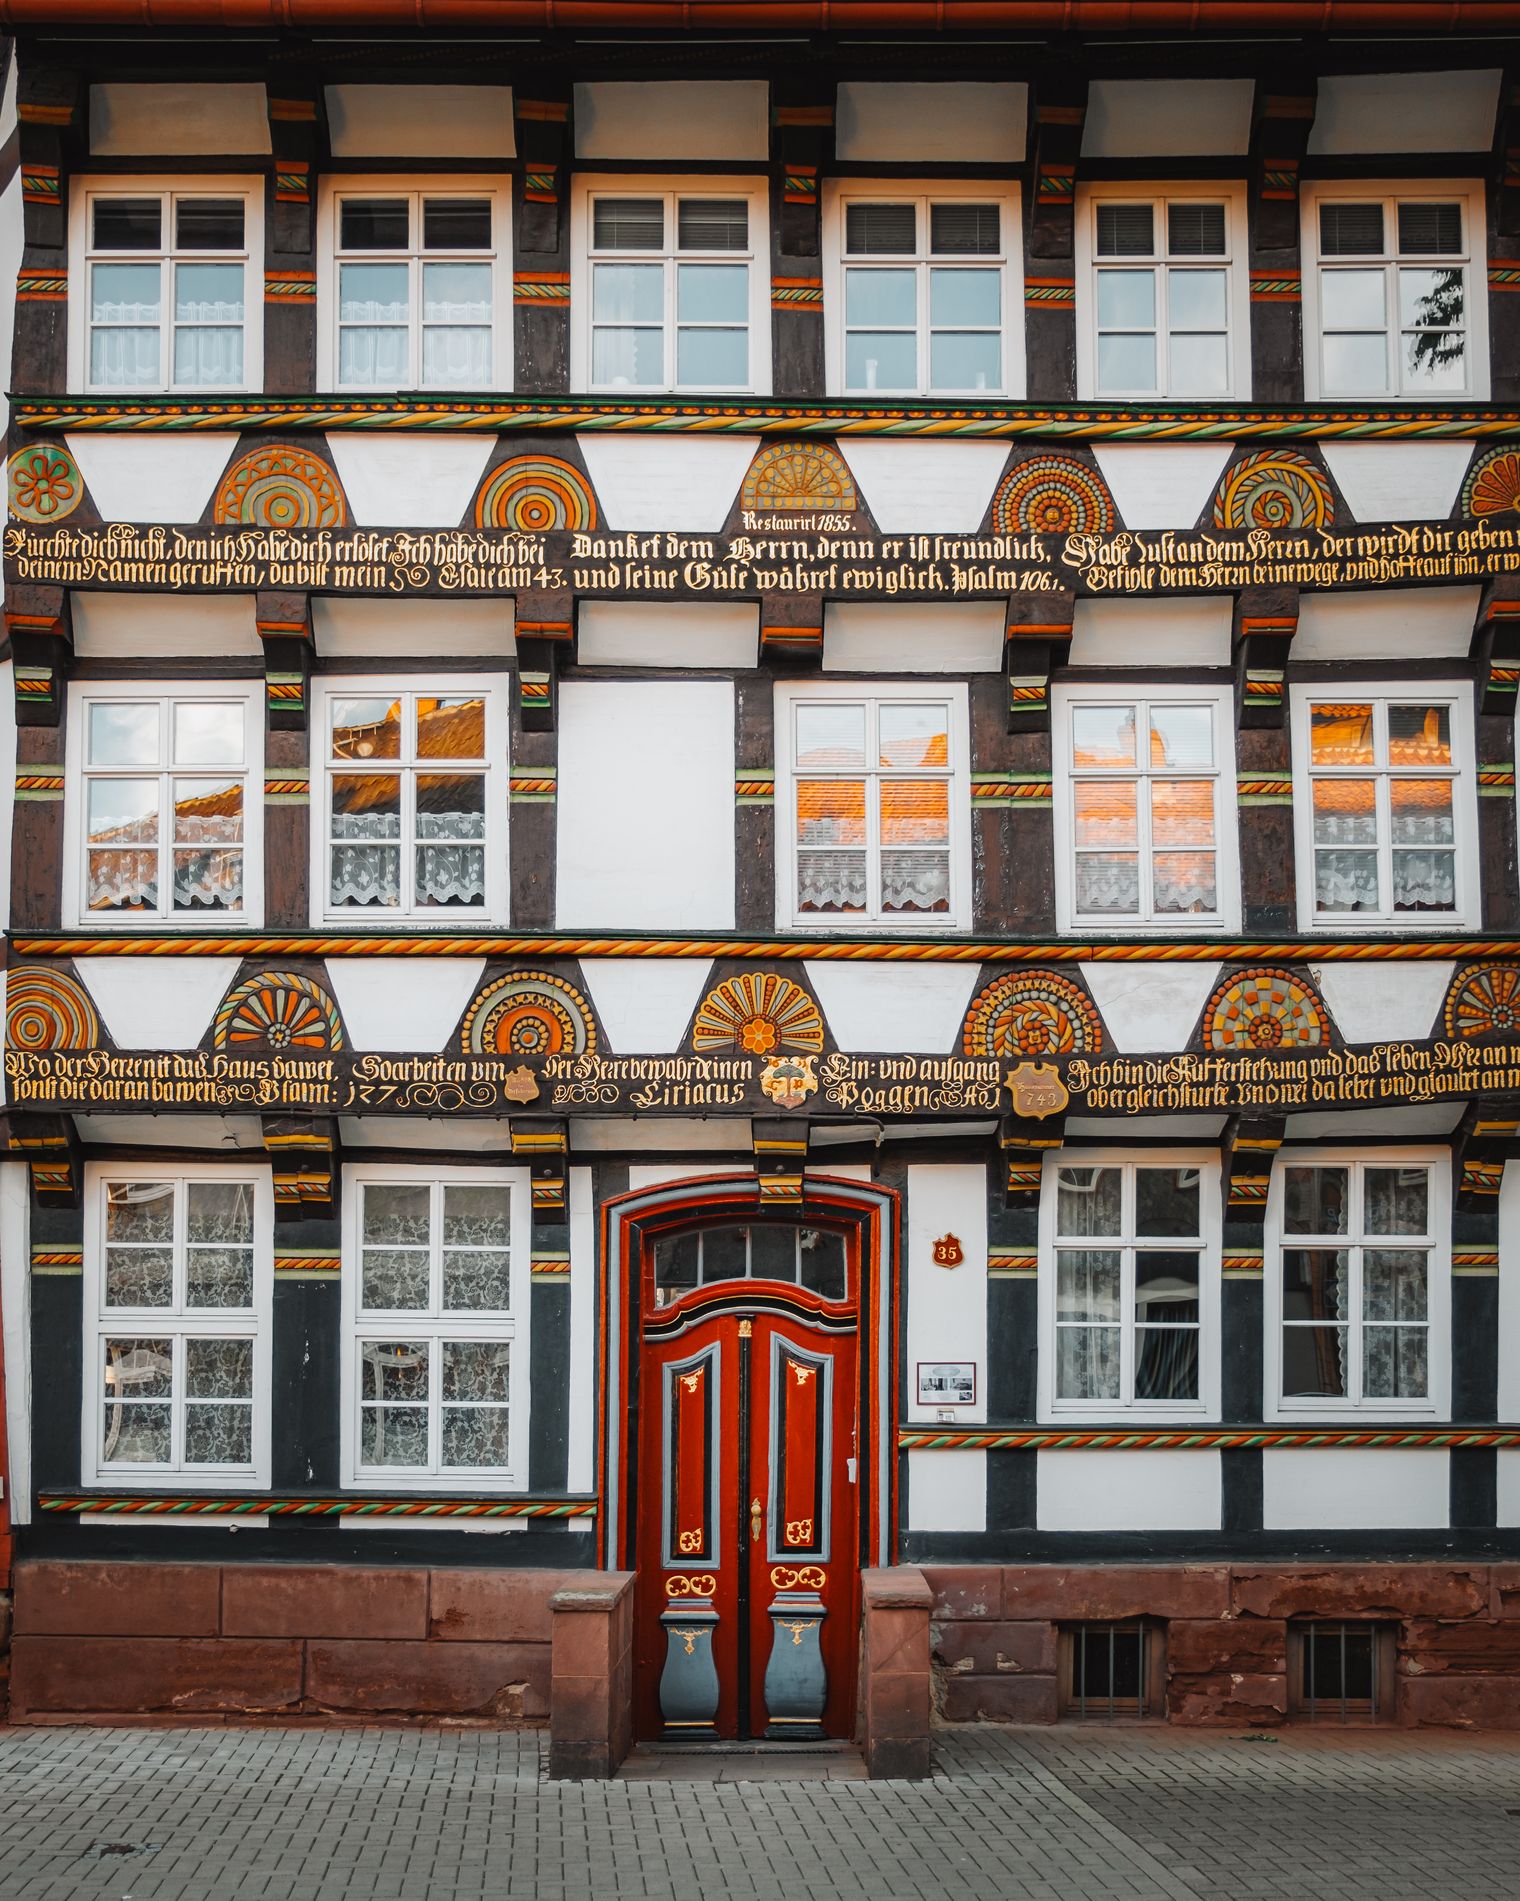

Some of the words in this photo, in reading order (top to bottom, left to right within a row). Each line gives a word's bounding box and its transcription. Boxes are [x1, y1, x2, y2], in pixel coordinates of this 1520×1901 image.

[817, 514, 857, 532] 1855.
[570, 533, 661, 559] Danket
[666, 532, 714, 559] dem
[722, 537, 814, 567] Herrn,
[816, 536, 875, 560] denn
[882, 540, 904, 560] er
[1201, 533, 1244, 562] dem
[1422, 526, 1454, 553] dir
[1457, 519, 1514, 557] geben
[574, 562, 621, 589] und
[683, 562, 748, 590] Güte
[752, 563, 838, 592] währet
[842, 563, 949, 594] ewiglich.
[1159, 563, 1197, 587] dem
[938, 1246, 957, 1260] 35
